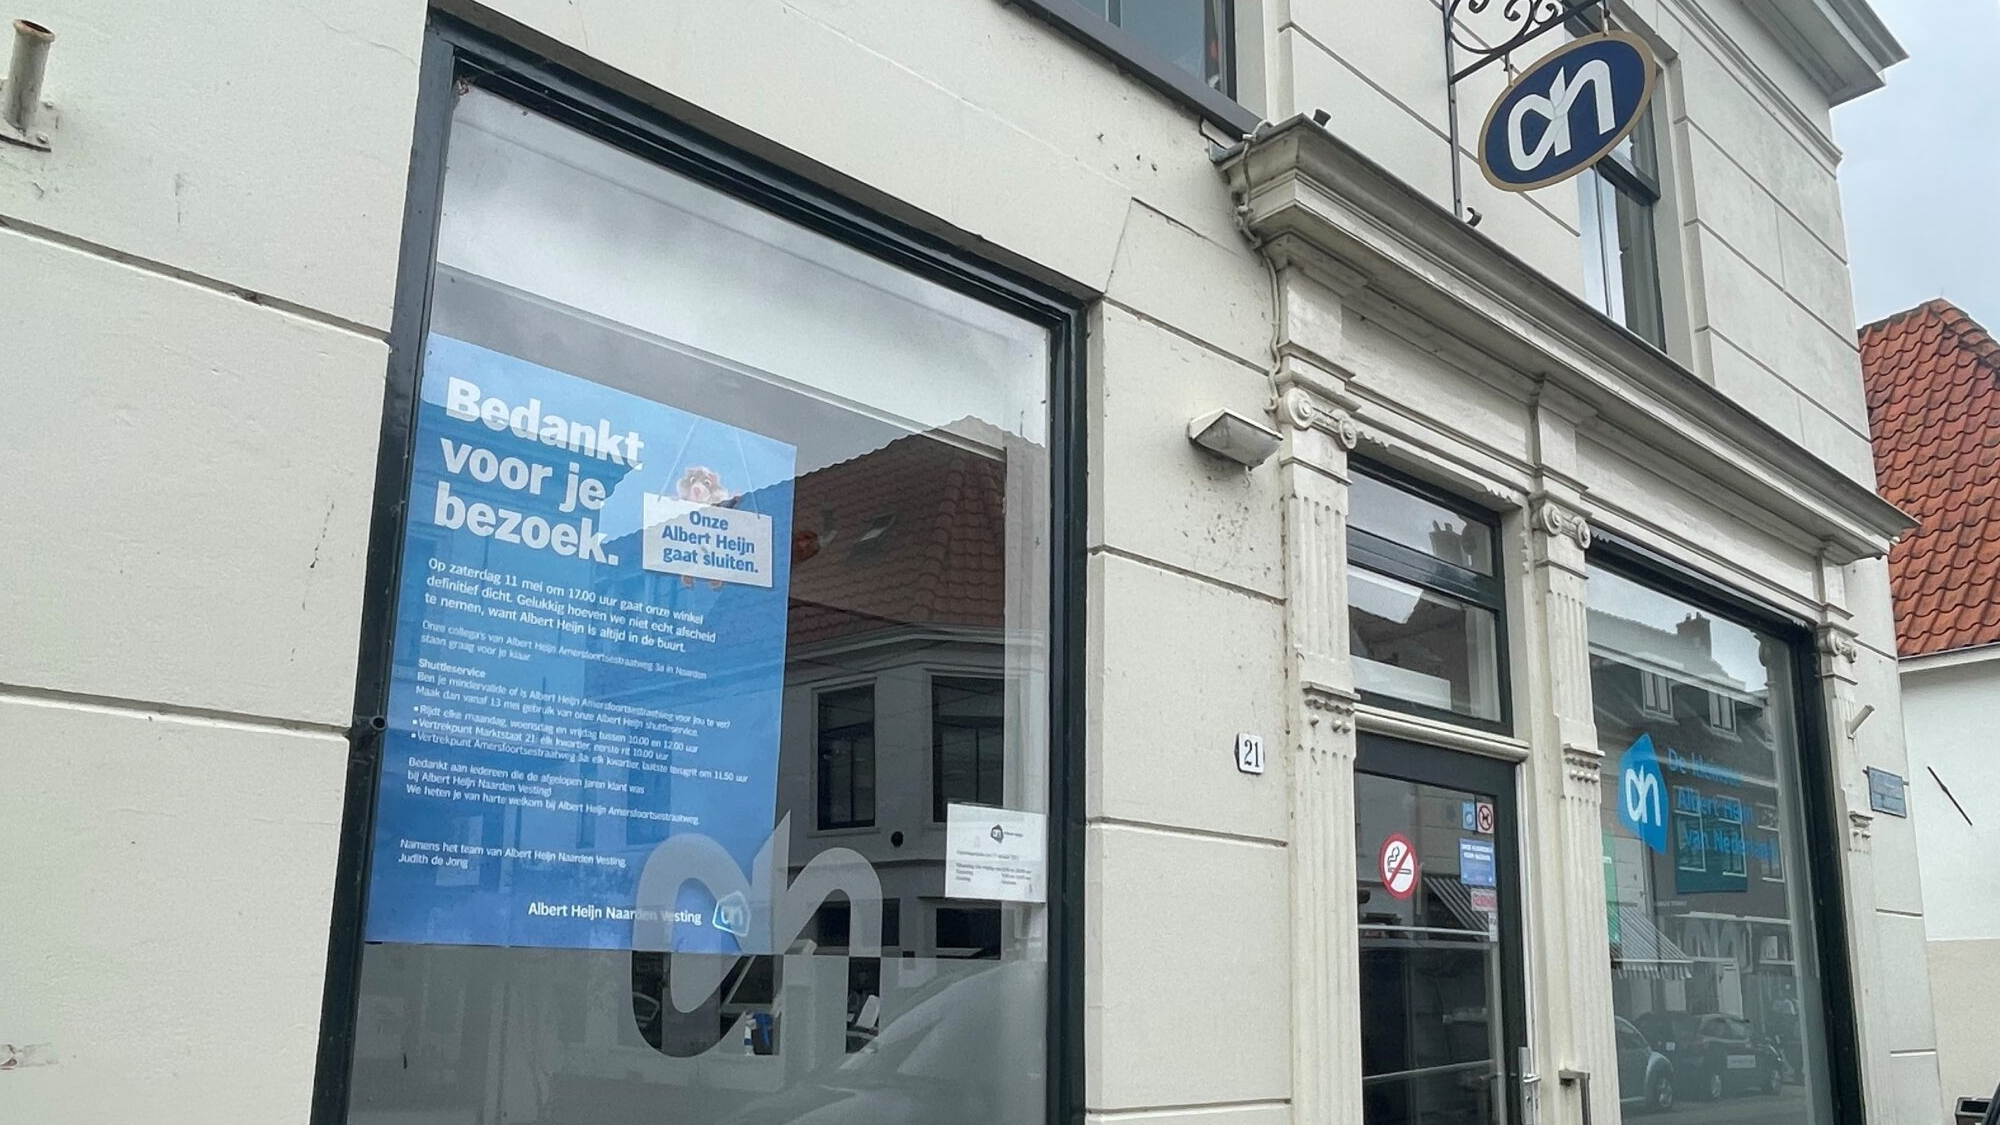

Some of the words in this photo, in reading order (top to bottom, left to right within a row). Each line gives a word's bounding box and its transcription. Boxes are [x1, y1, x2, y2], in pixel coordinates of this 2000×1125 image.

[446, 376, 645, 471] Bedankt
[440, 438, 553, 495] voor
[560, 461, 607, 514] je
[434, 480, 620, 567] bezoek.
[689, 511, 728, 531] Onze
[661, 525, 711, 548] Albert
[716, 532, 755, 555] Heijn
[663, 546, 698, 564] gaat
[703, 549, 759, 574] sluiten.
[427, 557, 445, 572] Op
[449, 562, 501, 585] zaterdag
[505, 574, 517, 586] 11
[521, 577, 543, 592] mei
[546, 584, 564, 596] om
[568, 587, 596, 602] 17.00
[599, 595, 617, 607] uur
[620, 598, 642, 614] gaat
[646, 605, 669, 617] onze
[672, 609, 703, 624] winkel
[424, 592, 437, 605] te
[440, 598, 484, 615] nemen,
[488, 605, 516, 621] want
[520, 612, 553, 628] Albert
[556, 618, 584, 635] Heijn
[587, 624, 596, 635] is
[599, 626, 625, 643] altijd
[628, 631, 637, 643] in
[641, 633, 654, 646] de
[657, 638, 686, 652] buurt.
[426, 574, 478, 596] definitief
[481, 586, 513, 603] dicht.
[516, 594, 564, 615] Gelukkig
[567, 604, 606, 621] hoeven
[610, 614, 625, 625] we
[628, 616, 648, 629] niet
[651, 620, 673, 634] echt
[675, 625, 716, 643] afscheid
[420, 633, 446, 646] staan
[448, 640, 474, 653] graag
[476, 644, 496, 655] voor
[498, 647, 506, 658] je
[422, 619, 446, 633] Onze
[488, 633, 503, 643] van
[506, 636, 531, 648] Albert
[534, 641, 556, 654] Heijn
[666, 664, 673, 673] in
[417, 658, 486, 678] Shuttleservice
[415, 685, 440, 697] Maak
[442, 689, 460, 701] dan
[463, 693, 487, 705] vanaf
[490, 697, 501, 707] 13
[503, 699, 520, 710] mei
[522, 703, 554, 717] gebruik
[557, 709, 571, 718] van
[574, 712, 594, 721] onze
[596, 714, 621, 725] Albert
[623, 717, 642, 729] Heijn
[416, 671, 434, 683] Ben
[437, 674, 446, 686] je
[448, 677, 506, 694] mindervalide
[508, 686, 518, 696] of
[529, 690, 555, 702] Albert
[558, 694, 579, 707] Heijn
[674, 714, 691, 723] voor
[692, 715, 704, 726] jou
[706, 718, 714, 727] te
[417, 719, 472, 736] Vertrekpunt
[655, 752, 669, 760] uur
[443, 708, 462, 719] elke
[509, 719, 553, 734] woensdag
[556, 726, 566, 734] en
[569, 727, 597, 740] vrijdag
[598, 732, 625, 742] tussen
[650, 739, 660, 747] en
[685, 744, 697, 753] uur
[416, 732, 471, 748] Vertrekpunt
[699, 770, 711, 778] om
[735, 774, 748, 782] uur
[1244, 739, 1260, 768] 21
[1668, 747, 1687, 774] De
[406, 770, 419, 782] bij
[421, 773, 450, 784] Albert
[452, 776, 475, 789] Heijn
[477, 780, 515, 791] Naarden
[408, 758, 448, 771] Bedankt
[450, 763, 467, 773] aan
[469, 765, 508, 778] iedereen
[510, 769, 524, 780] die
[526, 771, 538, 781] de
[540, 774, 582, 788] afgelopen
[584, 779, 605, 790] jaren
[607, 781, 627, 791] klant
[628, 784, 644, 794] was
[405, 784, 421, 794] We
[423, 786, 450, 797] heten
[452, 789, 461, 801] je
[464, 792, 480, 800] van
[482, 792, 506, 803] harte
[508, 796, 543, 807] welkom
[545, 799, 555, 810] bij
[558, 801, 583, 811] Albert
[585, 804, 606, 816] Heijn
[1678, 786, 1719, 818] Albert
[397, 853, 428, 864] Judith
[430, 855, 443, 865] de
[445, 856, 468, 869] Jong
[399, 840, 440, 851] Namens
[442, 842, 457, 852] het
[460, 844, 483, 854] team
[485, 848, 502, 856] van
[504, 848, 531, 858] Albert
[533, 850, 555, 862] Heijn
[558, 853, 593, 863] Naarden
[527, 901, 568, 917] Albert
[570, 903, 602, 921] Heijn
